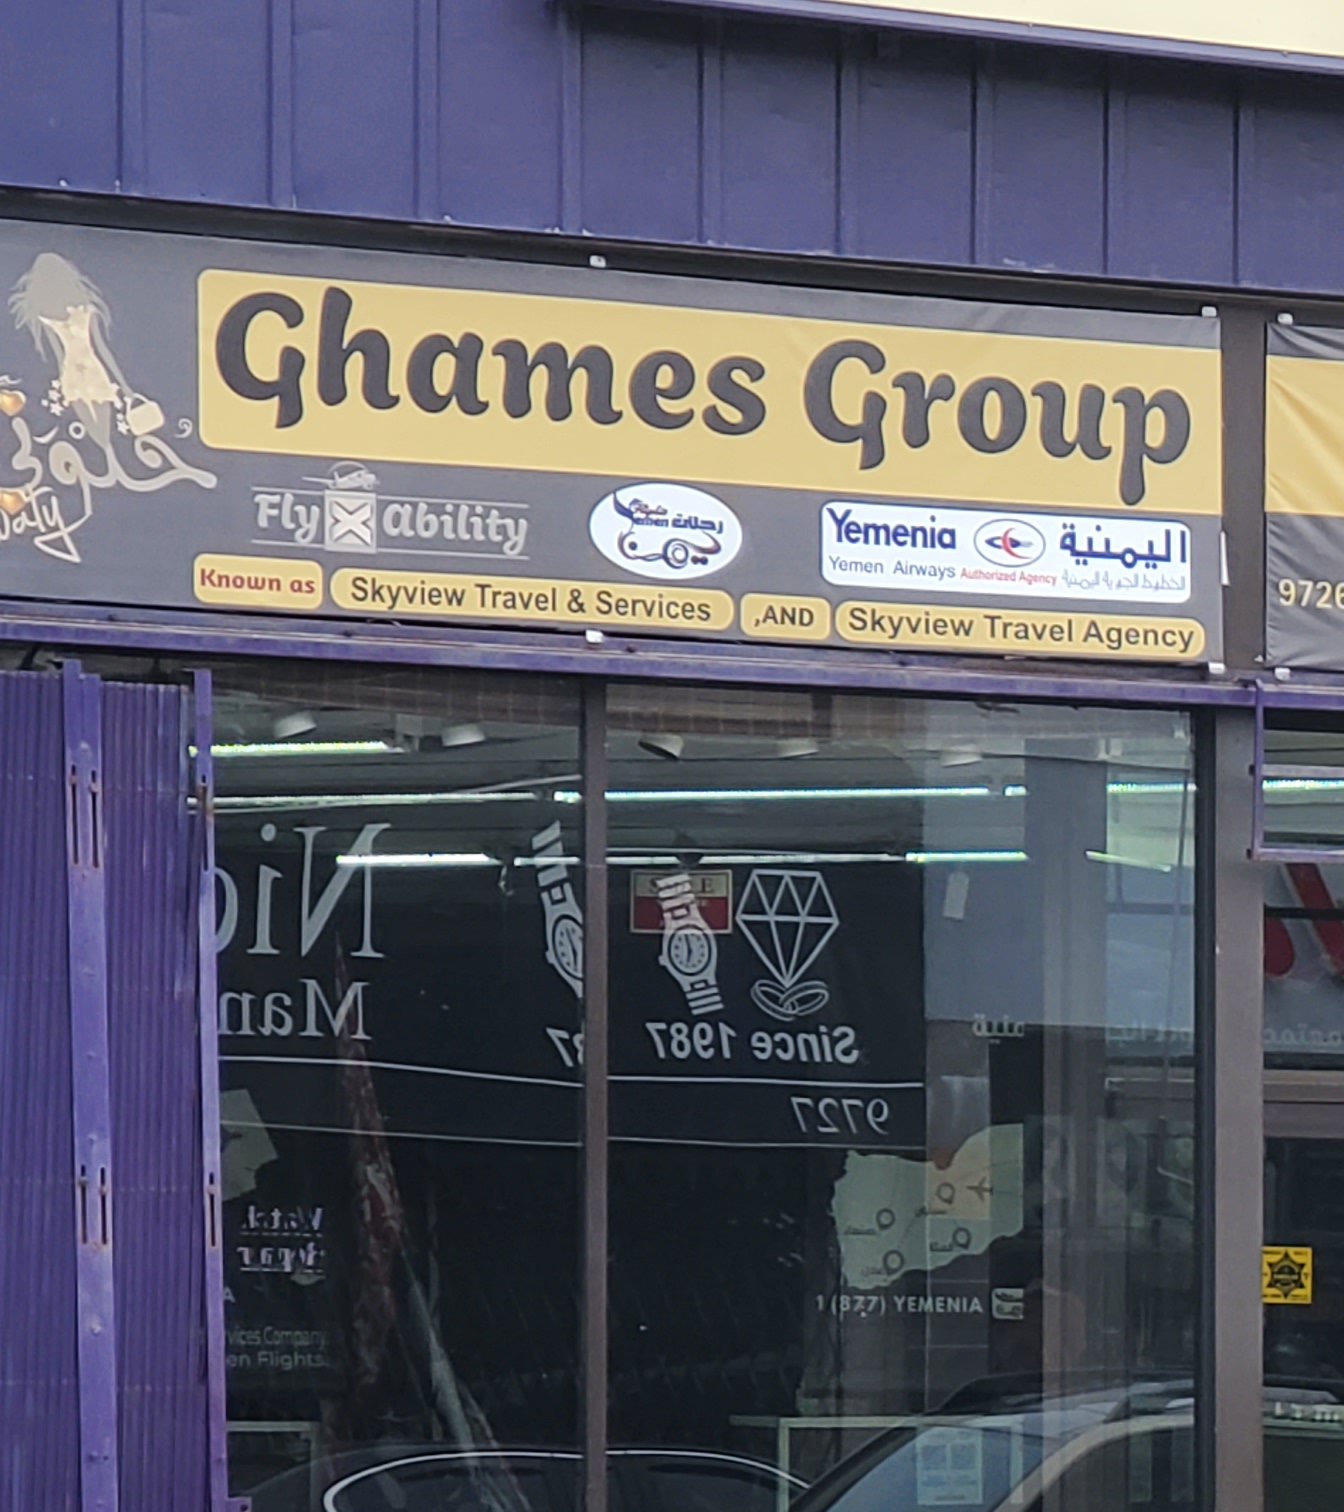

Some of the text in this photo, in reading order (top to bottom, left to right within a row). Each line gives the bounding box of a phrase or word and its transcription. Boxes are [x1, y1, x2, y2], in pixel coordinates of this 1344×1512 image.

[215, 286, 1191, 505] Ghames Group
[254, 493, 320, 543] Fly
[826, 508, 957, 550] Yemenia
[828, 555, 956, 579] Yemen Airways
[1059, 522, 1187, 569] اليمنية
[200, 569, 316, 595] Known as
[960, 567, 1058, 585] Authorized Agency
[350, 576, 712, 622] Skyview Travel & Services
[848, 607, 1195, 653] Skyview Travel Agency
[893, 1295, 984, 1314] YEMENIA
